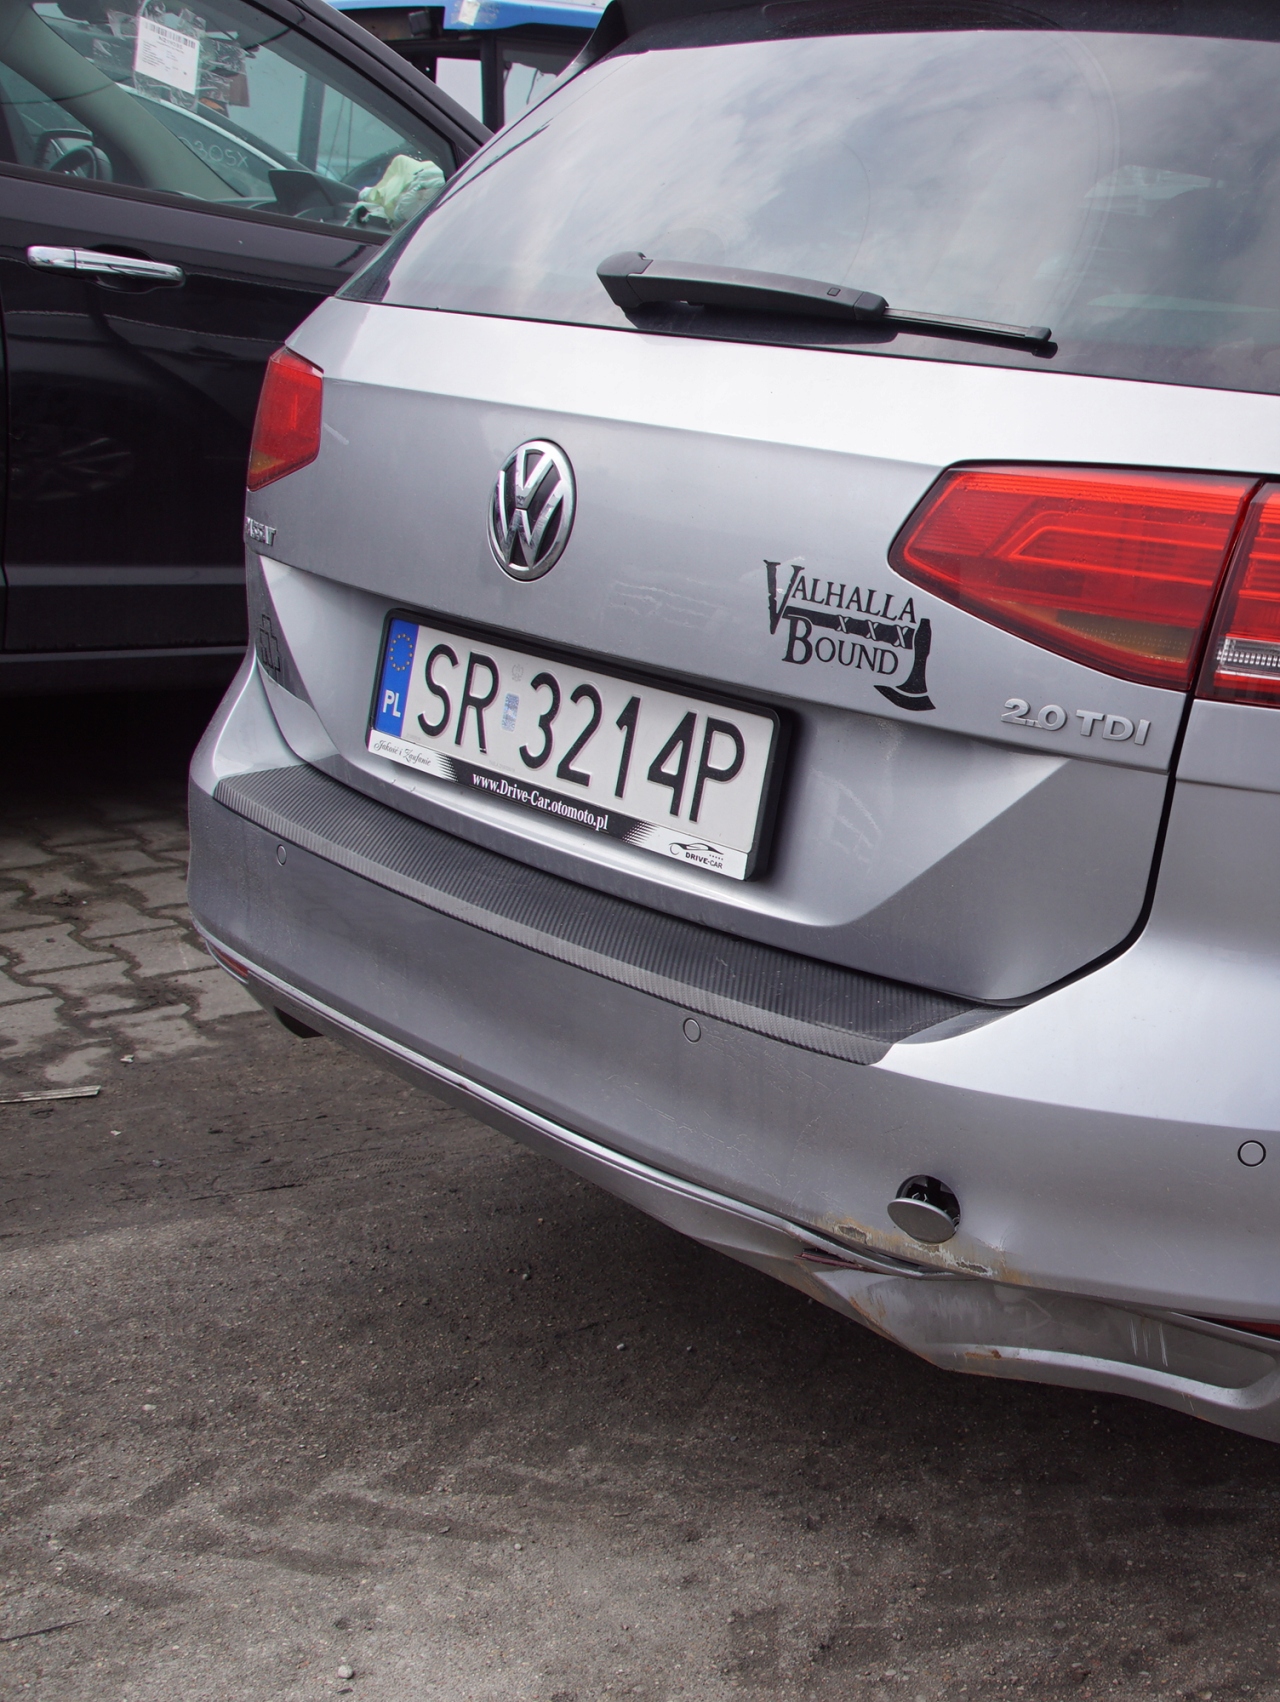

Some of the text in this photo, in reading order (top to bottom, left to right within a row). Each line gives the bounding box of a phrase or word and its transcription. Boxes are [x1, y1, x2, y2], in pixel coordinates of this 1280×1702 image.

[763, 559, 917, 635] VALHALLA
[782, 615, 899, 676] BOUND
[382, 690, 402, 719] PL
[417, 643, 746, 823] SR 3214P
[1001, 698, 1152, 746] 2.0 TDI
[472, 774, 609, 831] www.Drive-Car.otomoto.pl
[685, 852, 723, 869] DRIVE-CAR
